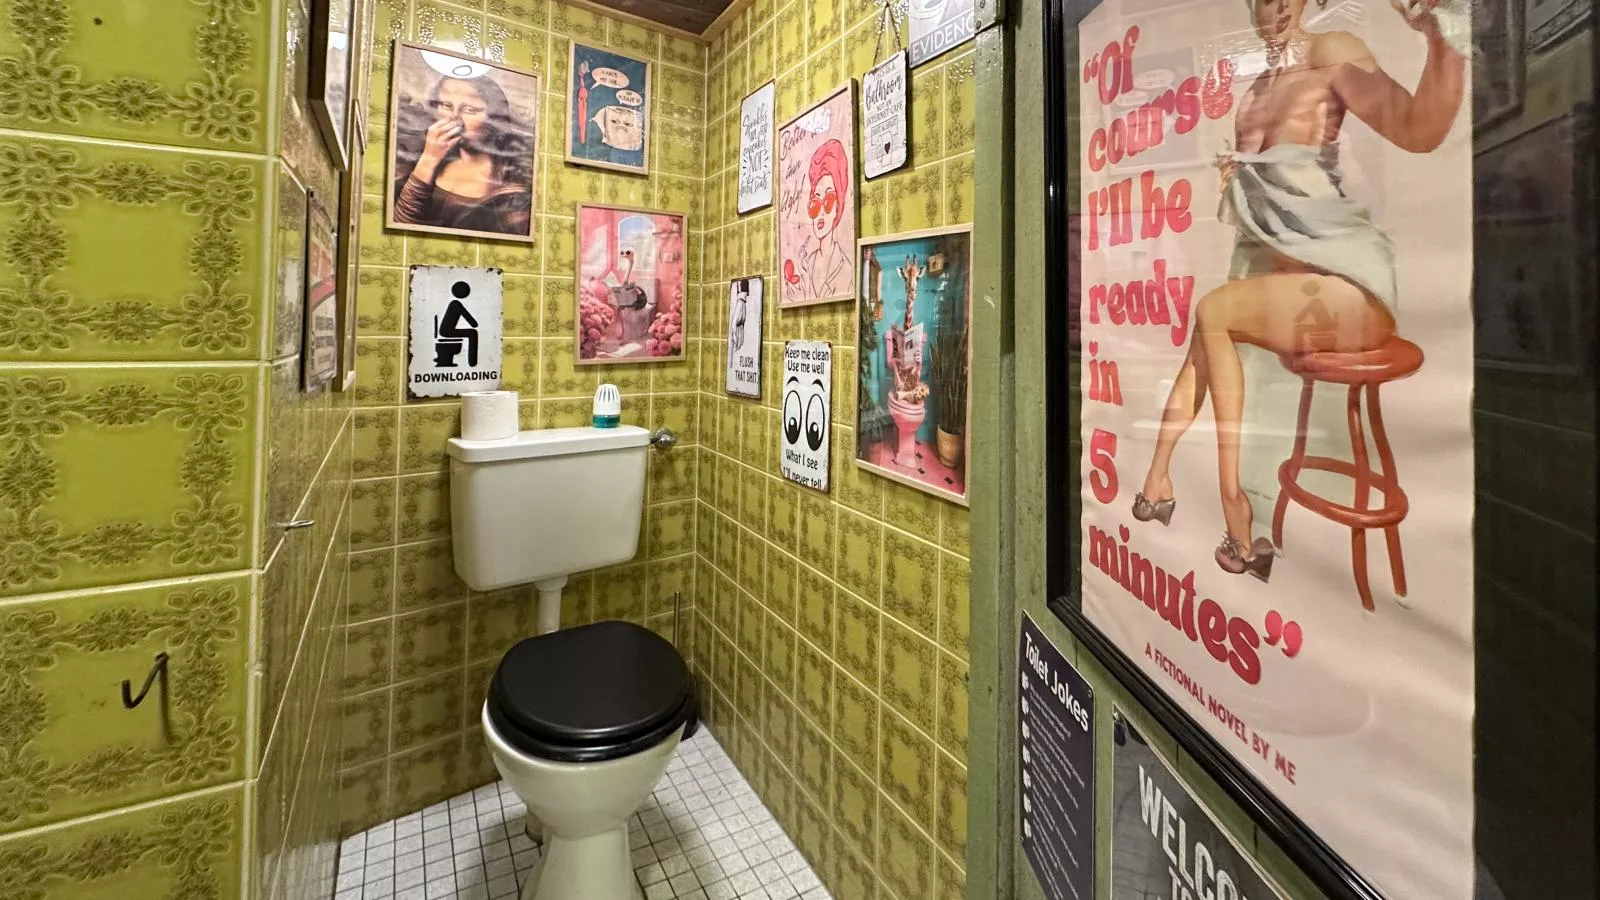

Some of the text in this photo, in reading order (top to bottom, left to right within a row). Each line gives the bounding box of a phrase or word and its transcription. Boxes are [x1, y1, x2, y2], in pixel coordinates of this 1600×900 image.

[1088, 58, 1234, 172] course
[1088, 169, 1192, 250] I'll be
[1088, 259, 1194, 347] ready
[414, 371, 498, 383] DOWNLOADING
[735, 370, 746, 381] THAT
[740, 356, 754, 368] FLUSH
[785, 348, 829, 361] Keep me clean
[787, 360, 825, 375] Use me well
[1089, 340, 1123, 407] in
[785, 449, 801, 464] What
[807, 457, 818, 470] see
[1089, 428, 1118, 504] 5
[1025, 631, 1049, 687] Toilet
[1050, 669, 1089, 732] Jokes
[1145, 641, 1297, 786] A FICTIONAL NOVEL BY ME
